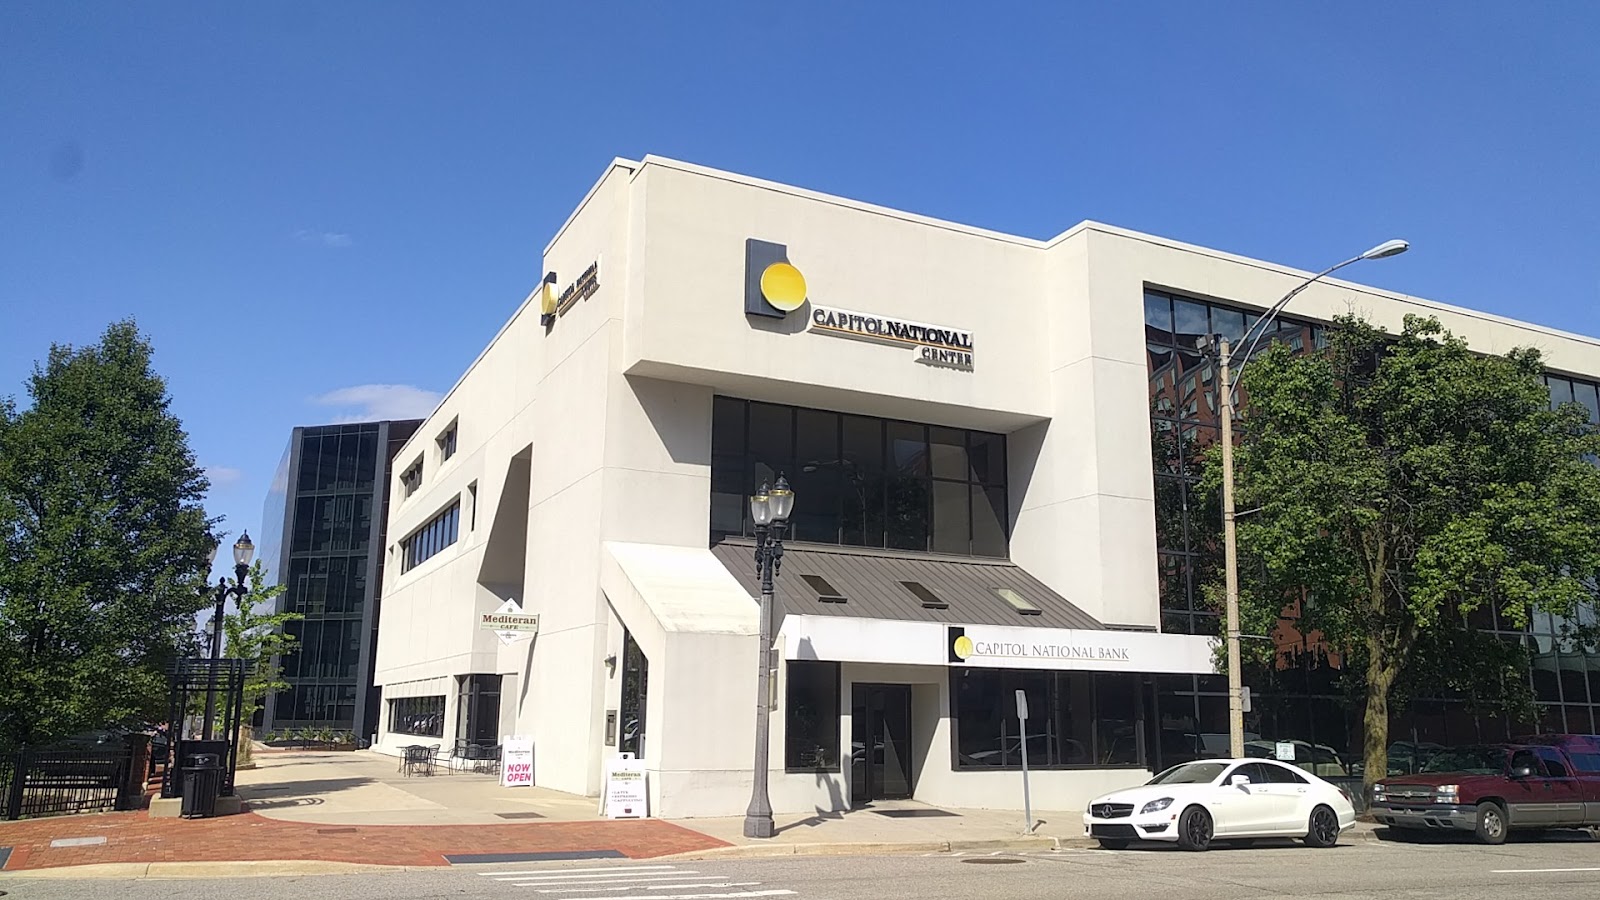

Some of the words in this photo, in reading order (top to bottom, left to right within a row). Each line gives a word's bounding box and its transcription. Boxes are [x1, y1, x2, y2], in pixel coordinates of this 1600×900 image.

[921, 347, 972, 366] CENTER
[482, 614, 537, 625] Mediteran
[975, 642, 1028, 657] CAPITOL
[1032, 645, 1095, 659] NATIONAL
[1098, 647, 1129, 660] BANK
[507, 764, 531, 773] NOW
[507, 773, 532, 782] OPEN
